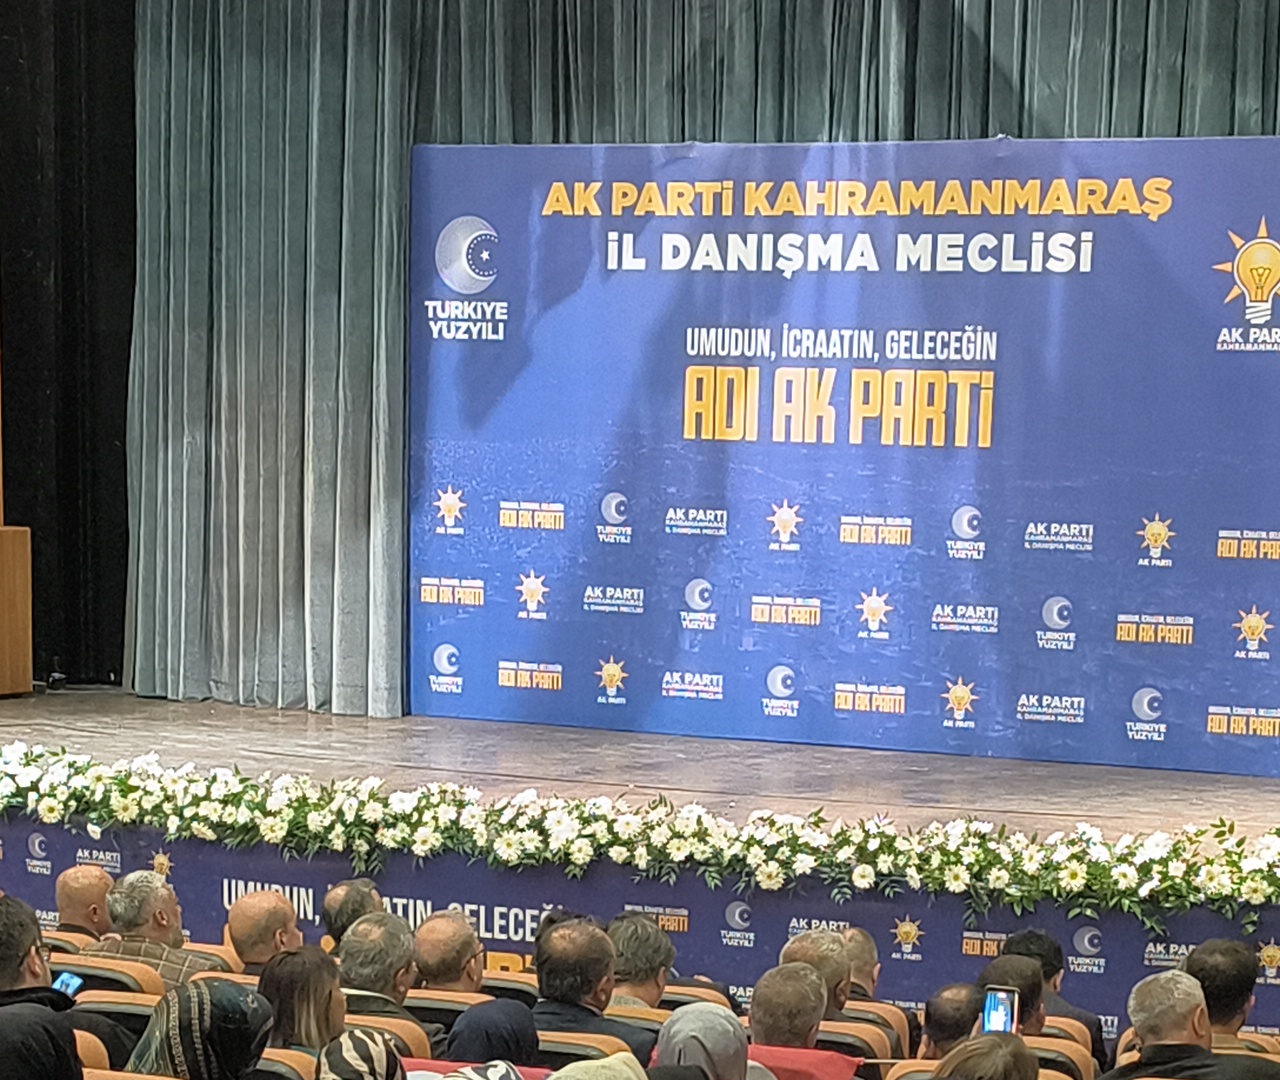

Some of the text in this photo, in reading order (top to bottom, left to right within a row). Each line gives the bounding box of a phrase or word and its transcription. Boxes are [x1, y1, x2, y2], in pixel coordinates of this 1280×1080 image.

[541, 181, 603, 216] AK
[744, 178, 1173, 222] KAHRAMANMARAŞ
[661, 233, 879, 279] DANIŞMA
[1217, 328, 1244, 342] AK
[686, 323, 997, 363] UMUDUN, İCRAATIN, GELECEĞİN
[683, 365, 759, 441] ADI
[772, 367, 837, 444] AK
[666, 508, 686, 520] AK
[1025, 522, 1048, 535] AK
[584, 586, 604, 598] AK
[932, 604, 954, 617] AK
[663, 671, 682, 683] AK
[1018, 694, 1038, 706] AK
[77, 848, 90, 859] AK
[789, 918, 809, 930] AK
[1145, 942, 1166, 953] AK
